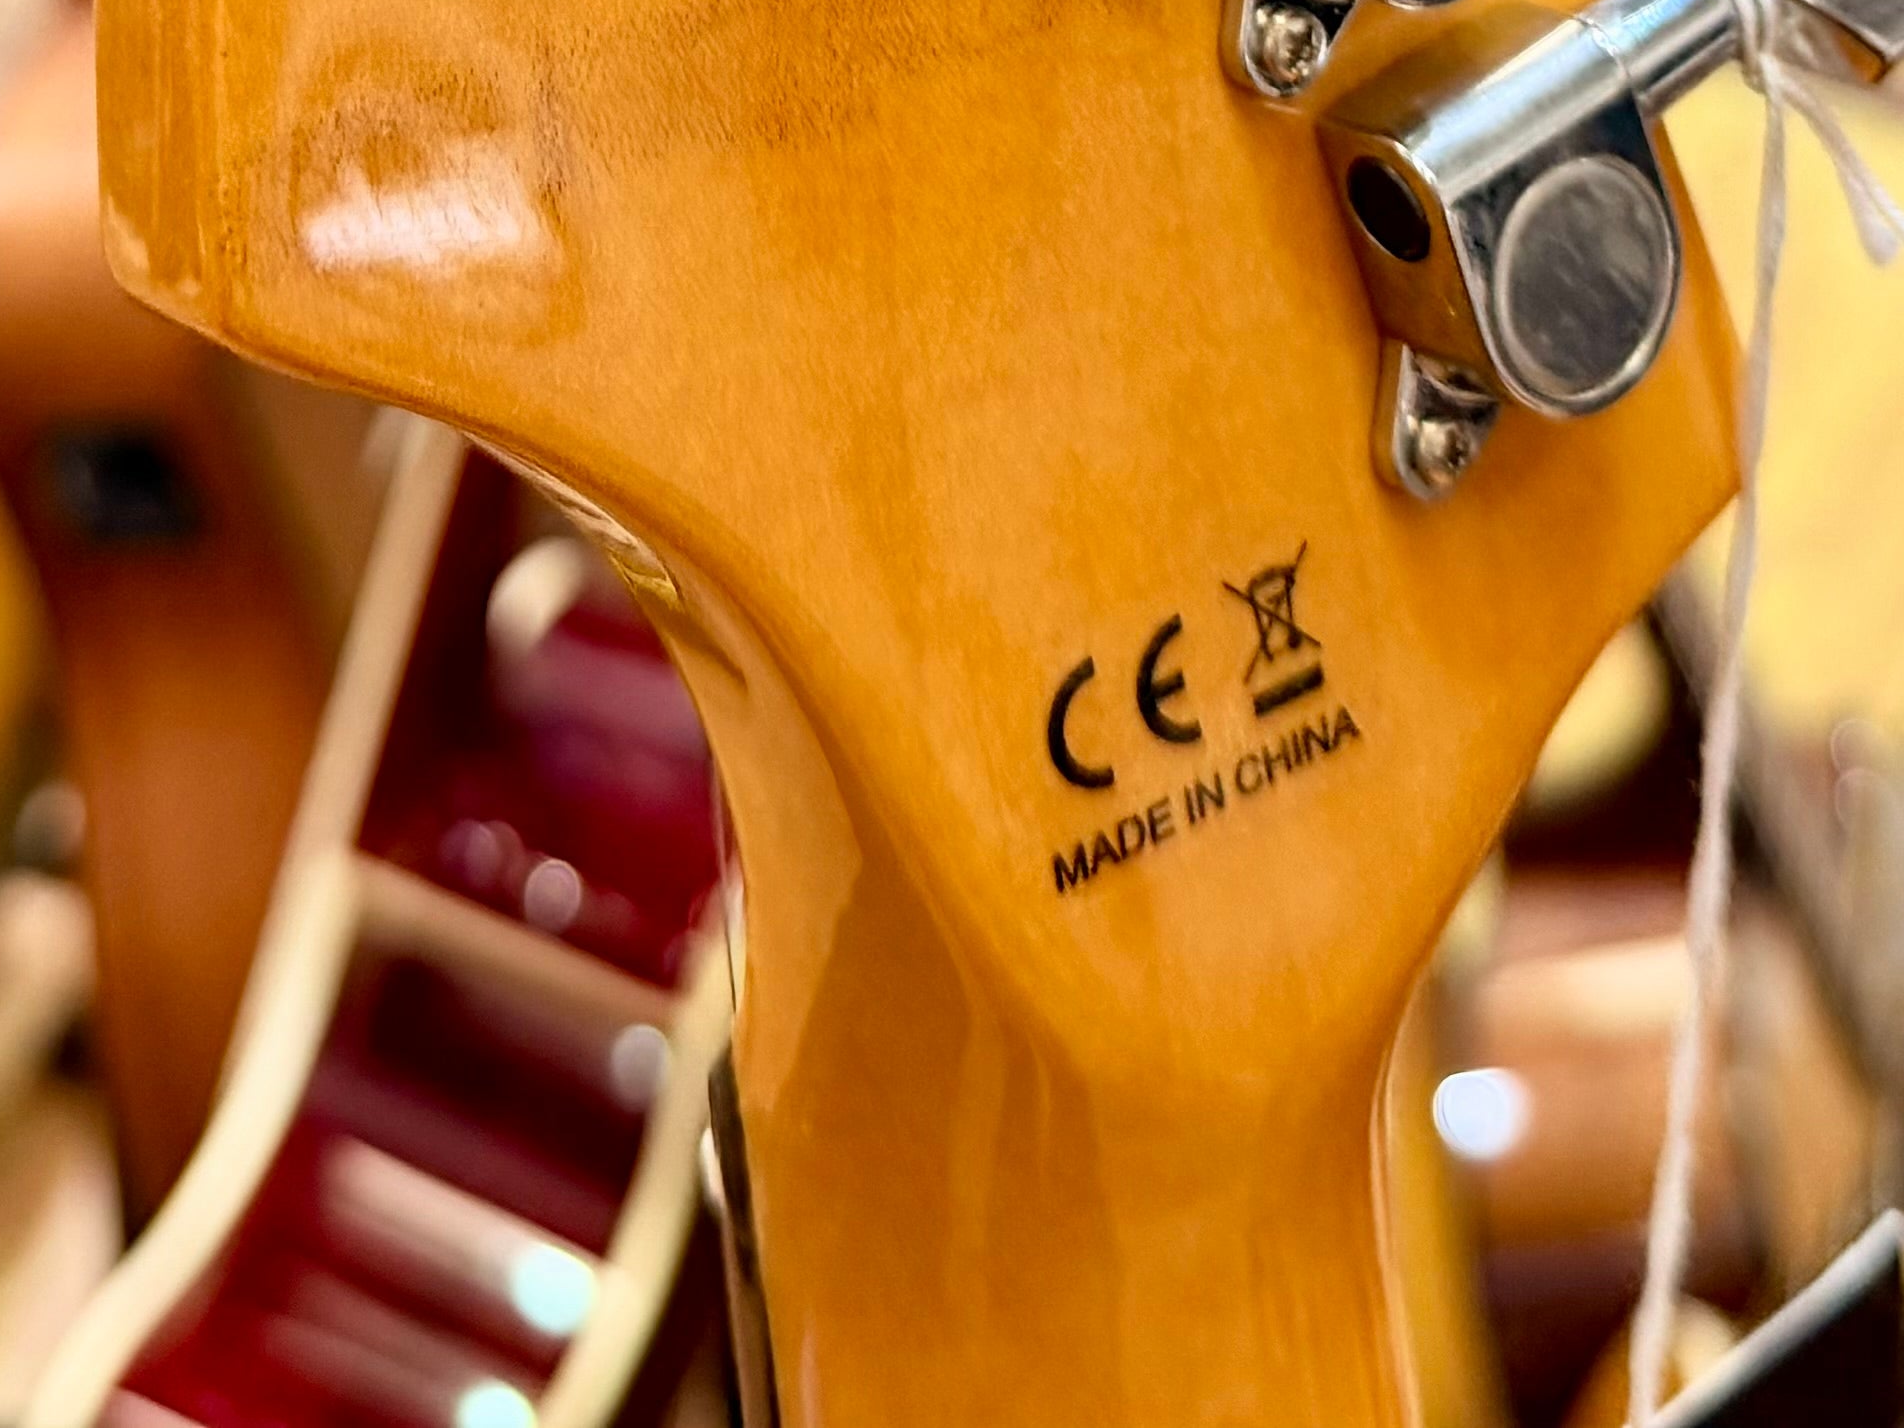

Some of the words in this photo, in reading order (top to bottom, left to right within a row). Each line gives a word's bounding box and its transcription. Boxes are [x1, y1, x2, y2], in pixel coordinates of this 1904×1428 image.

[1047, 612, 1202, 790] CE
[1052, 794, 1176, 894] MADE
[1182, 771, 1226, 826] IN
[1234, 704, 1361, 796] CHINA
